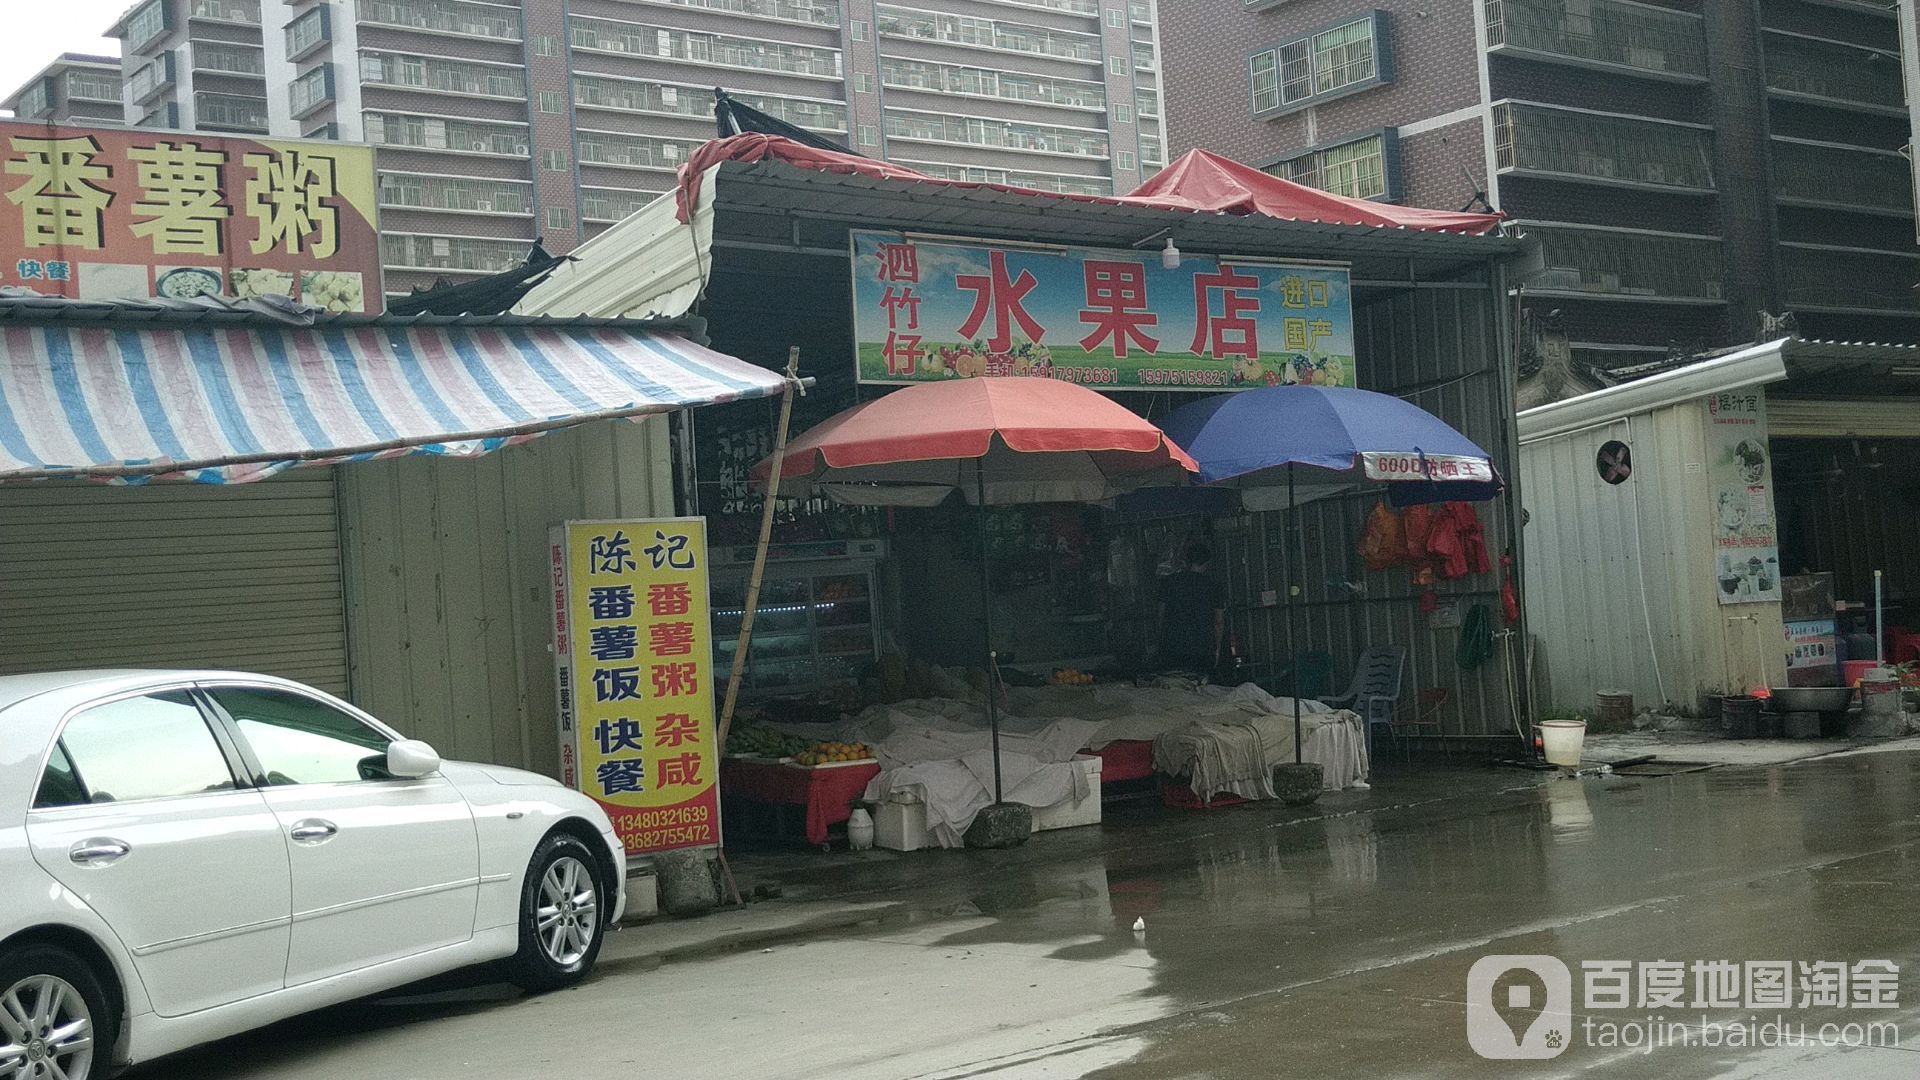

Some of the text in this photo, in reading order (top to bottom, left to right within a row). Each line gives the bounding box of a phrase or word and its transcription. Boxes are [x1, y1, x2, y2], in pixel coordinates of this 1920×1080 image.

[4, 135, 341, 259] 番薯粥
[17, 259, 71, 281] 快餐
[875, 241, 926, 376] 泗竹仔
[956, 250, 1262, 360] 水果店
[1279, 275, 1330, 310] 进口
[1283, 315, 1333, 352] 国产
[589, 530, 696, 575] 陈记
[552, 544, 568, 655] 陈记番薯粥
[559, 666, 572, 732] 番薯饭
[588, 583, 644, 797] 番薯饭 快餐
[647, 581, 703, 790] 番薯粥 杂咸
[617, 805, 708, 831] 13480321639
